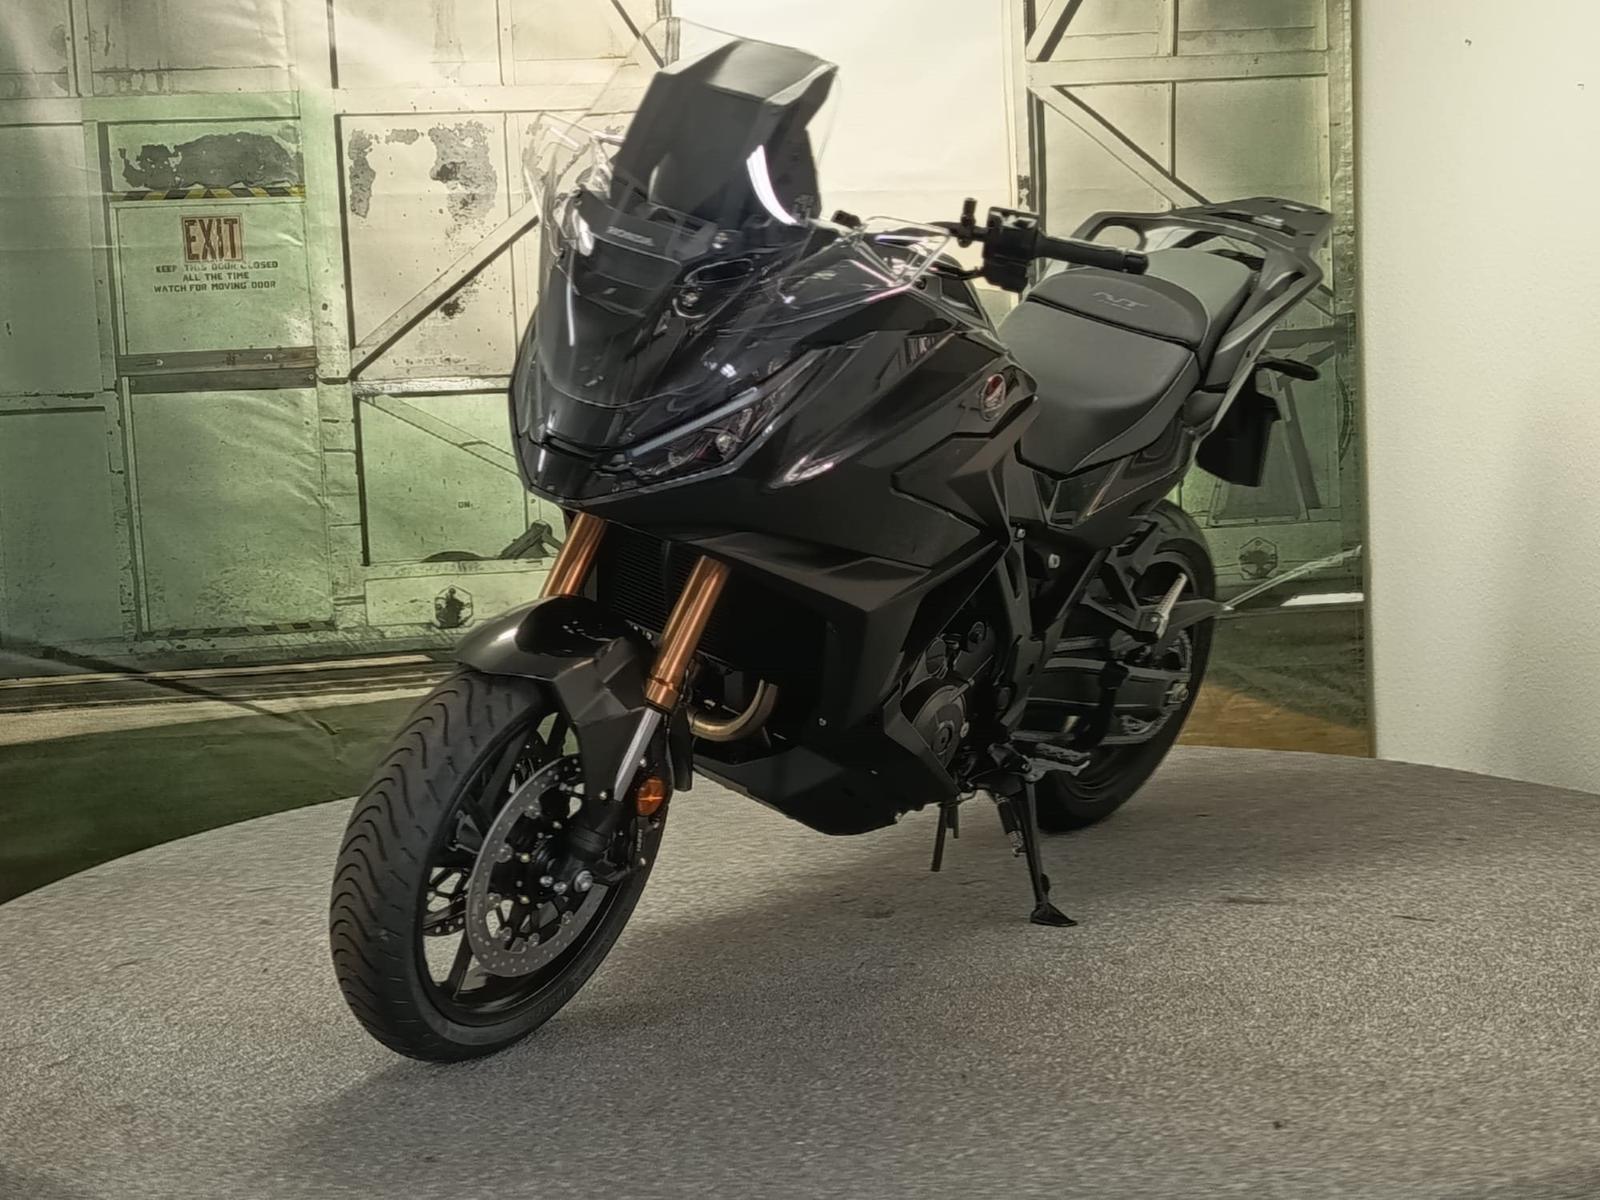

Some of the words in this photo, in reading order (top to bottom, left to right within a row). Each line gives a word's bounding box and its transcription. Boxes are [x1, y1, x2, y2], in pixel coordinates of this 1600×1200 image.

[184, 218, 238, 260] EXIT
[155, 265, 177, 273] KEEP
[183, 274, 200, 282] ALL
[205, 272, 223, 281] THE
[227, 271, 250, 280] TIME
[154, 284, 187, 293] WATCH
[189, 283, 207, 292] FOR
[211, 282, 247, 291] MOVING
[251, 281, 276, 289] DOOR
